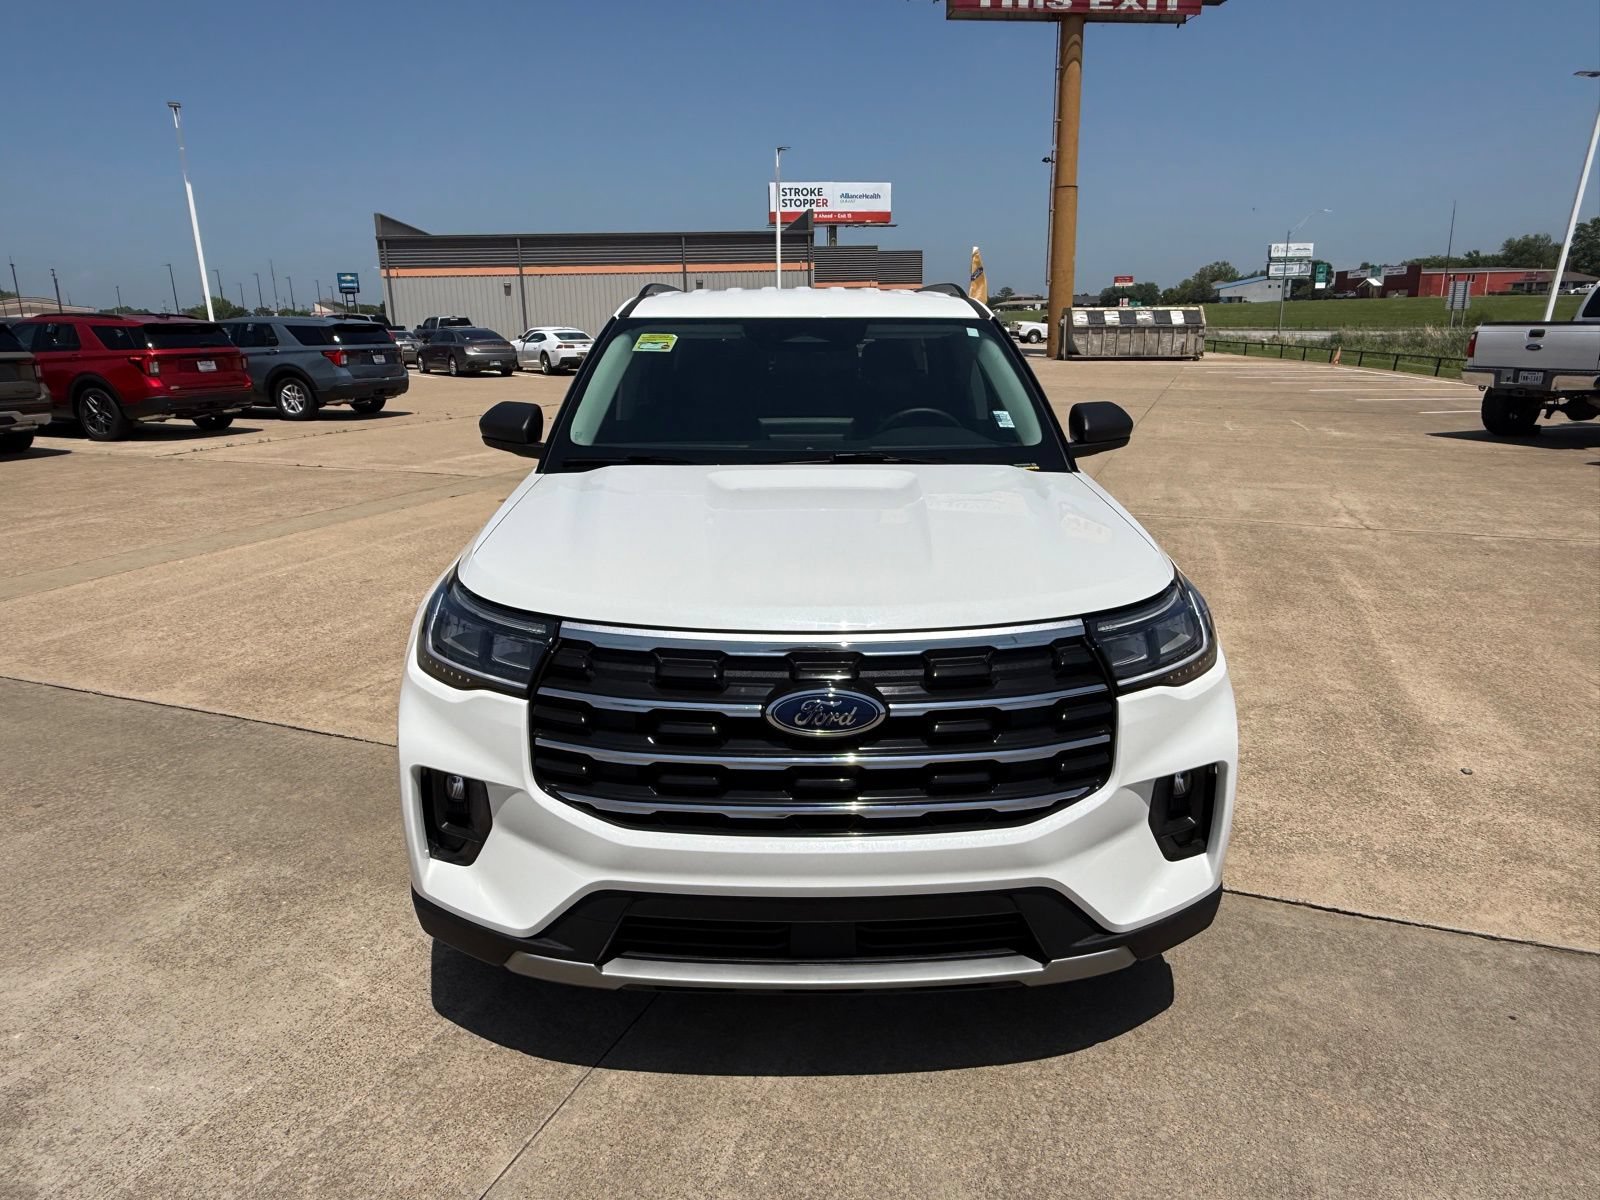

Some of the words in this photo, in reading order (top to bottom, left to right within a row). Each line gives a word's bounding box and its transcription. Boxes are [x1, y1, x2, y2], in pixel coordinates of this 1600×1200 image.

[781, 188, 823, 197] STROKE
[782, 199, 828, 207] STOPPER
[794, 699, 858, 726] Ford
